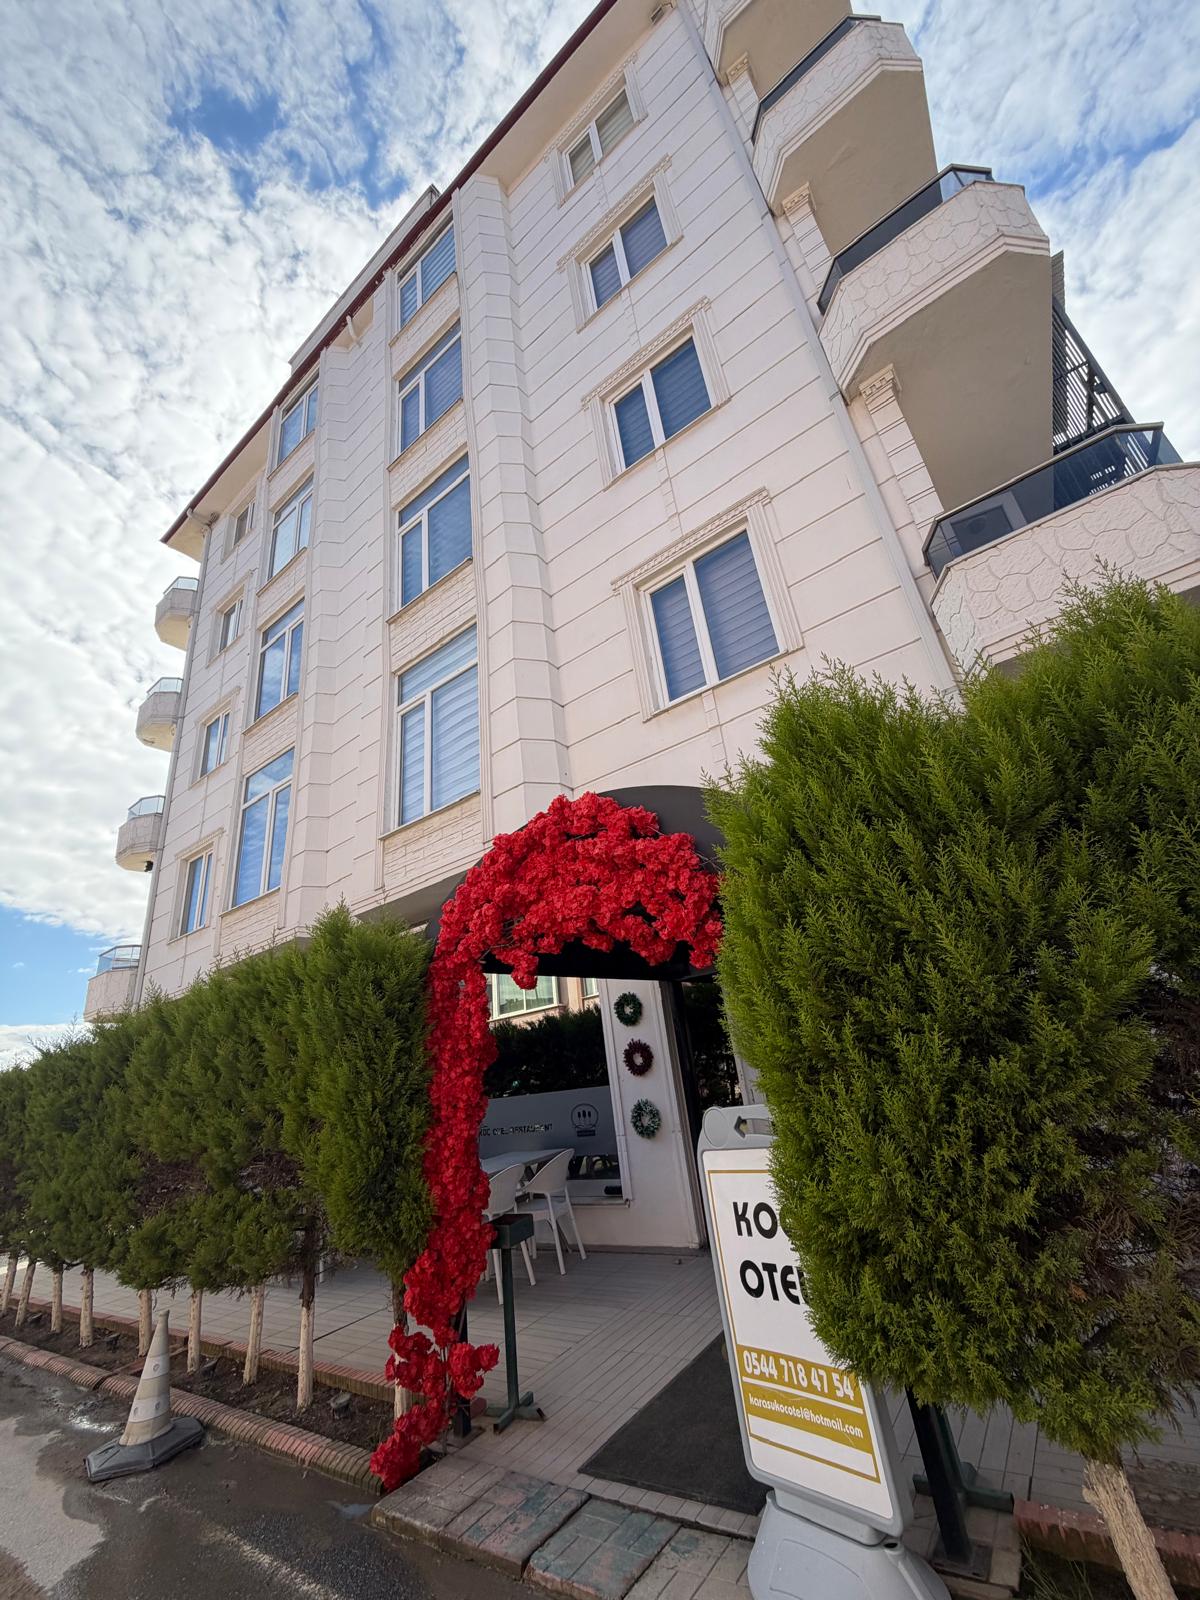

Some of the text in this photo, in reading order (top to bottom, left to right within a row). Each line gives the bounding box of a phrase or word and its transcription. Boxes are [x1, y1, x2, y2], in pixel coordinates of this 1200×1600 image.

[509, 1123, 553, 1134] ESTAUNT
[733, 1202, 795, 1248] KO
[743, 1350, 855, 1400] 0544 718 47 54
[748, 1393, 864, 1438] karasukocotel@hotmail.com
